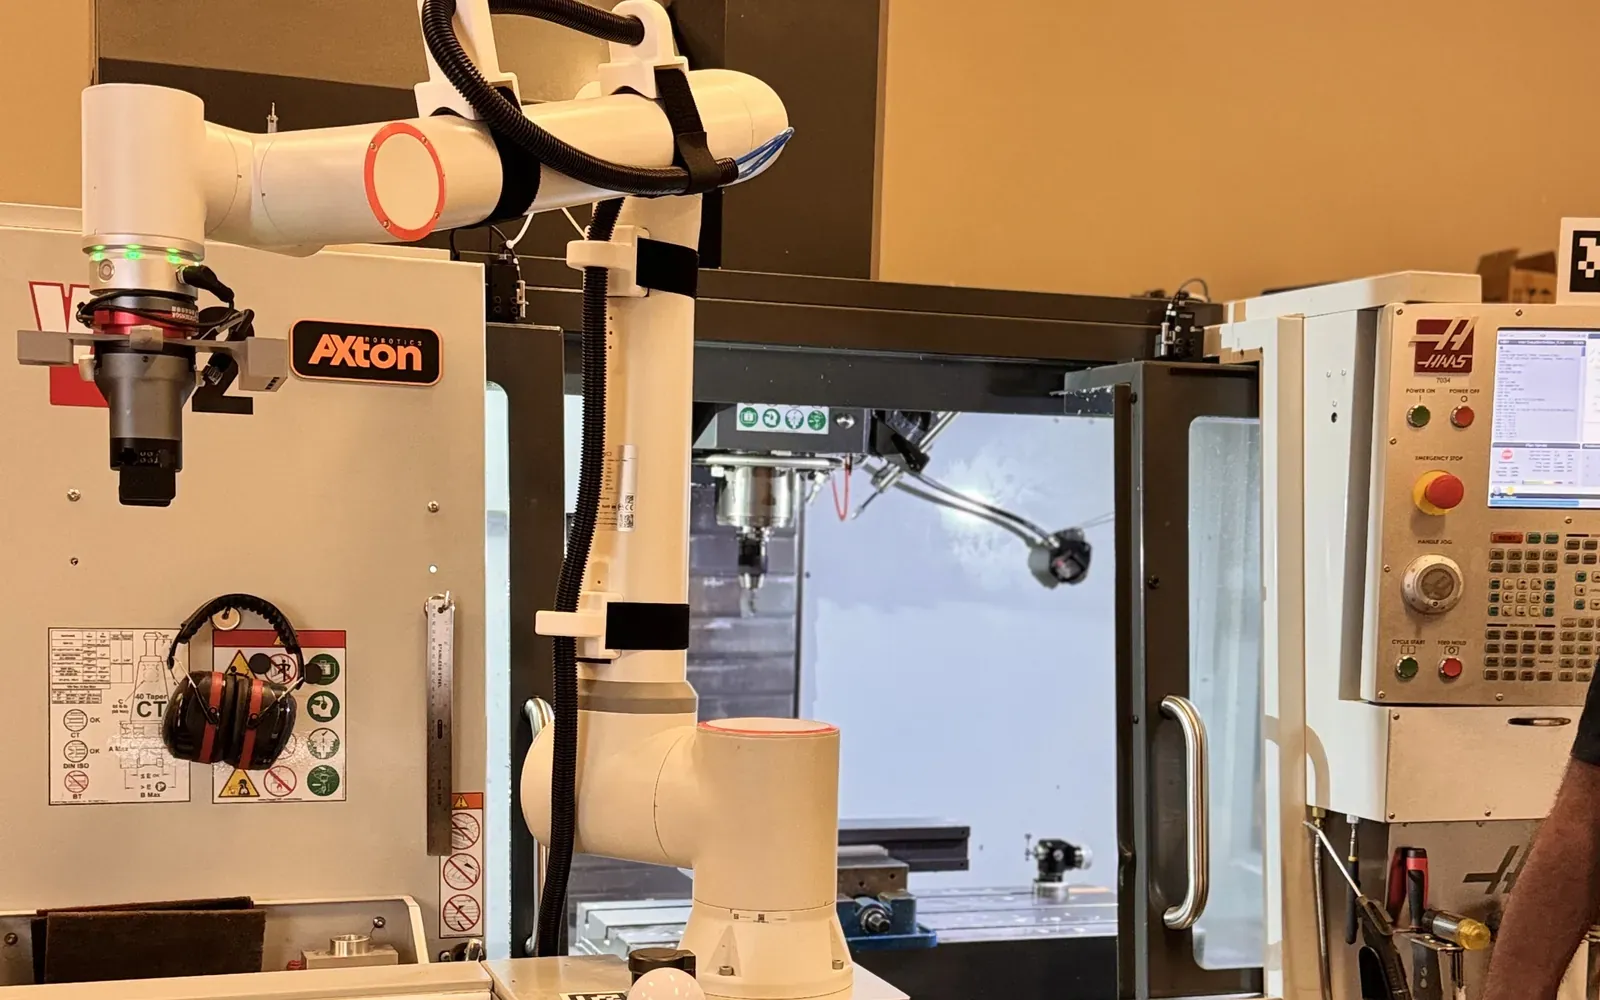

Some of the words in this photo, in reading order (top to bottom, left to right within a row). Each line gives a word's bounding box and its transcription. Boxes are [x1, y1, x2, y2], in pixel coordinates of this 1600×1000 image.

[365, 336, 422, 347] ROBOTICS
[308, 333, 422, 371] AXton
[1417, 354, 1472, 368] HAAS
[137, 701, 167, 717] CT
